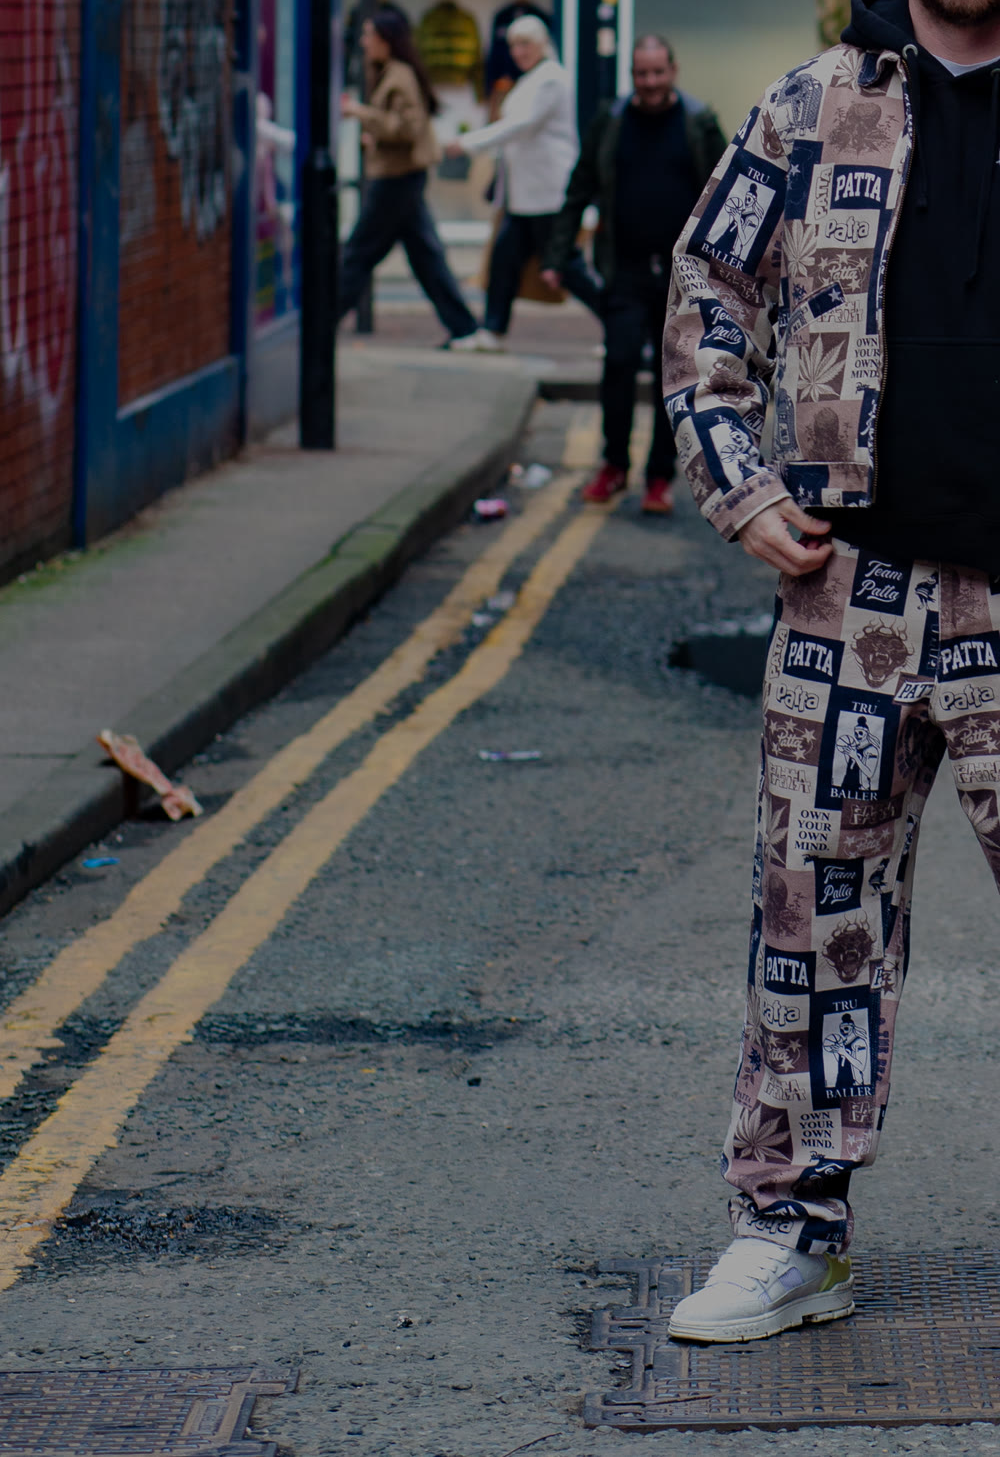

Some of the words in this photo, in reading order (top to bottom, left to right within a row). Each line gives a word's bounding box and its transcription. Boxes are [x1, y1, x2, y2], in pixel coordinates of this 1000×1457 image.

[747, 166, 771, 185] TRU
[834, 171, 882, 203] PATTA
[825, 215, 870, 244] Patta
[700, 242, 745, 272] BALLER
[704, 325, 742, 345] Patta
[856, 338, 878, 347] OWN
[854, 348, 880, 358] YOUR
[854, 358, 878, 369] OWN
[865, 560, 903, 580] Team
[856, 579, 900, 603] Patta
[787, 640, 834, 678] PATTA
[940, 641, 998, 675] PATTA
[776, 683, 820, 712] Patta
[903, 684, 934, 700] PATT
[938, 683, 995, 711] Patta
[851, 701, 878, 715] TRU
[959, 725, 993, 745] Patta
[830, 787, 878, 801] BALLER
[801, 809, 830, 821] OWN
[798, 819, 832, 832] YOUR
[799, 830, 828, 842] OWN
[794, 840, 830, 852] MIND.
[823, 865, 857, 885] Team
[820, 883, 854, 906] Patta
[766, 956, 809, 988] PATTA
[832, 999, 858, 1012] TRU
[826, 1086, 873, 1100] BALLER
[800, 1112, 830, 1120] OWN
[800, 1120, 834, 1129] YOUR
[803, 1130, 832, 1138] OWN
[801, 1139, 835, 1149] MIND.
